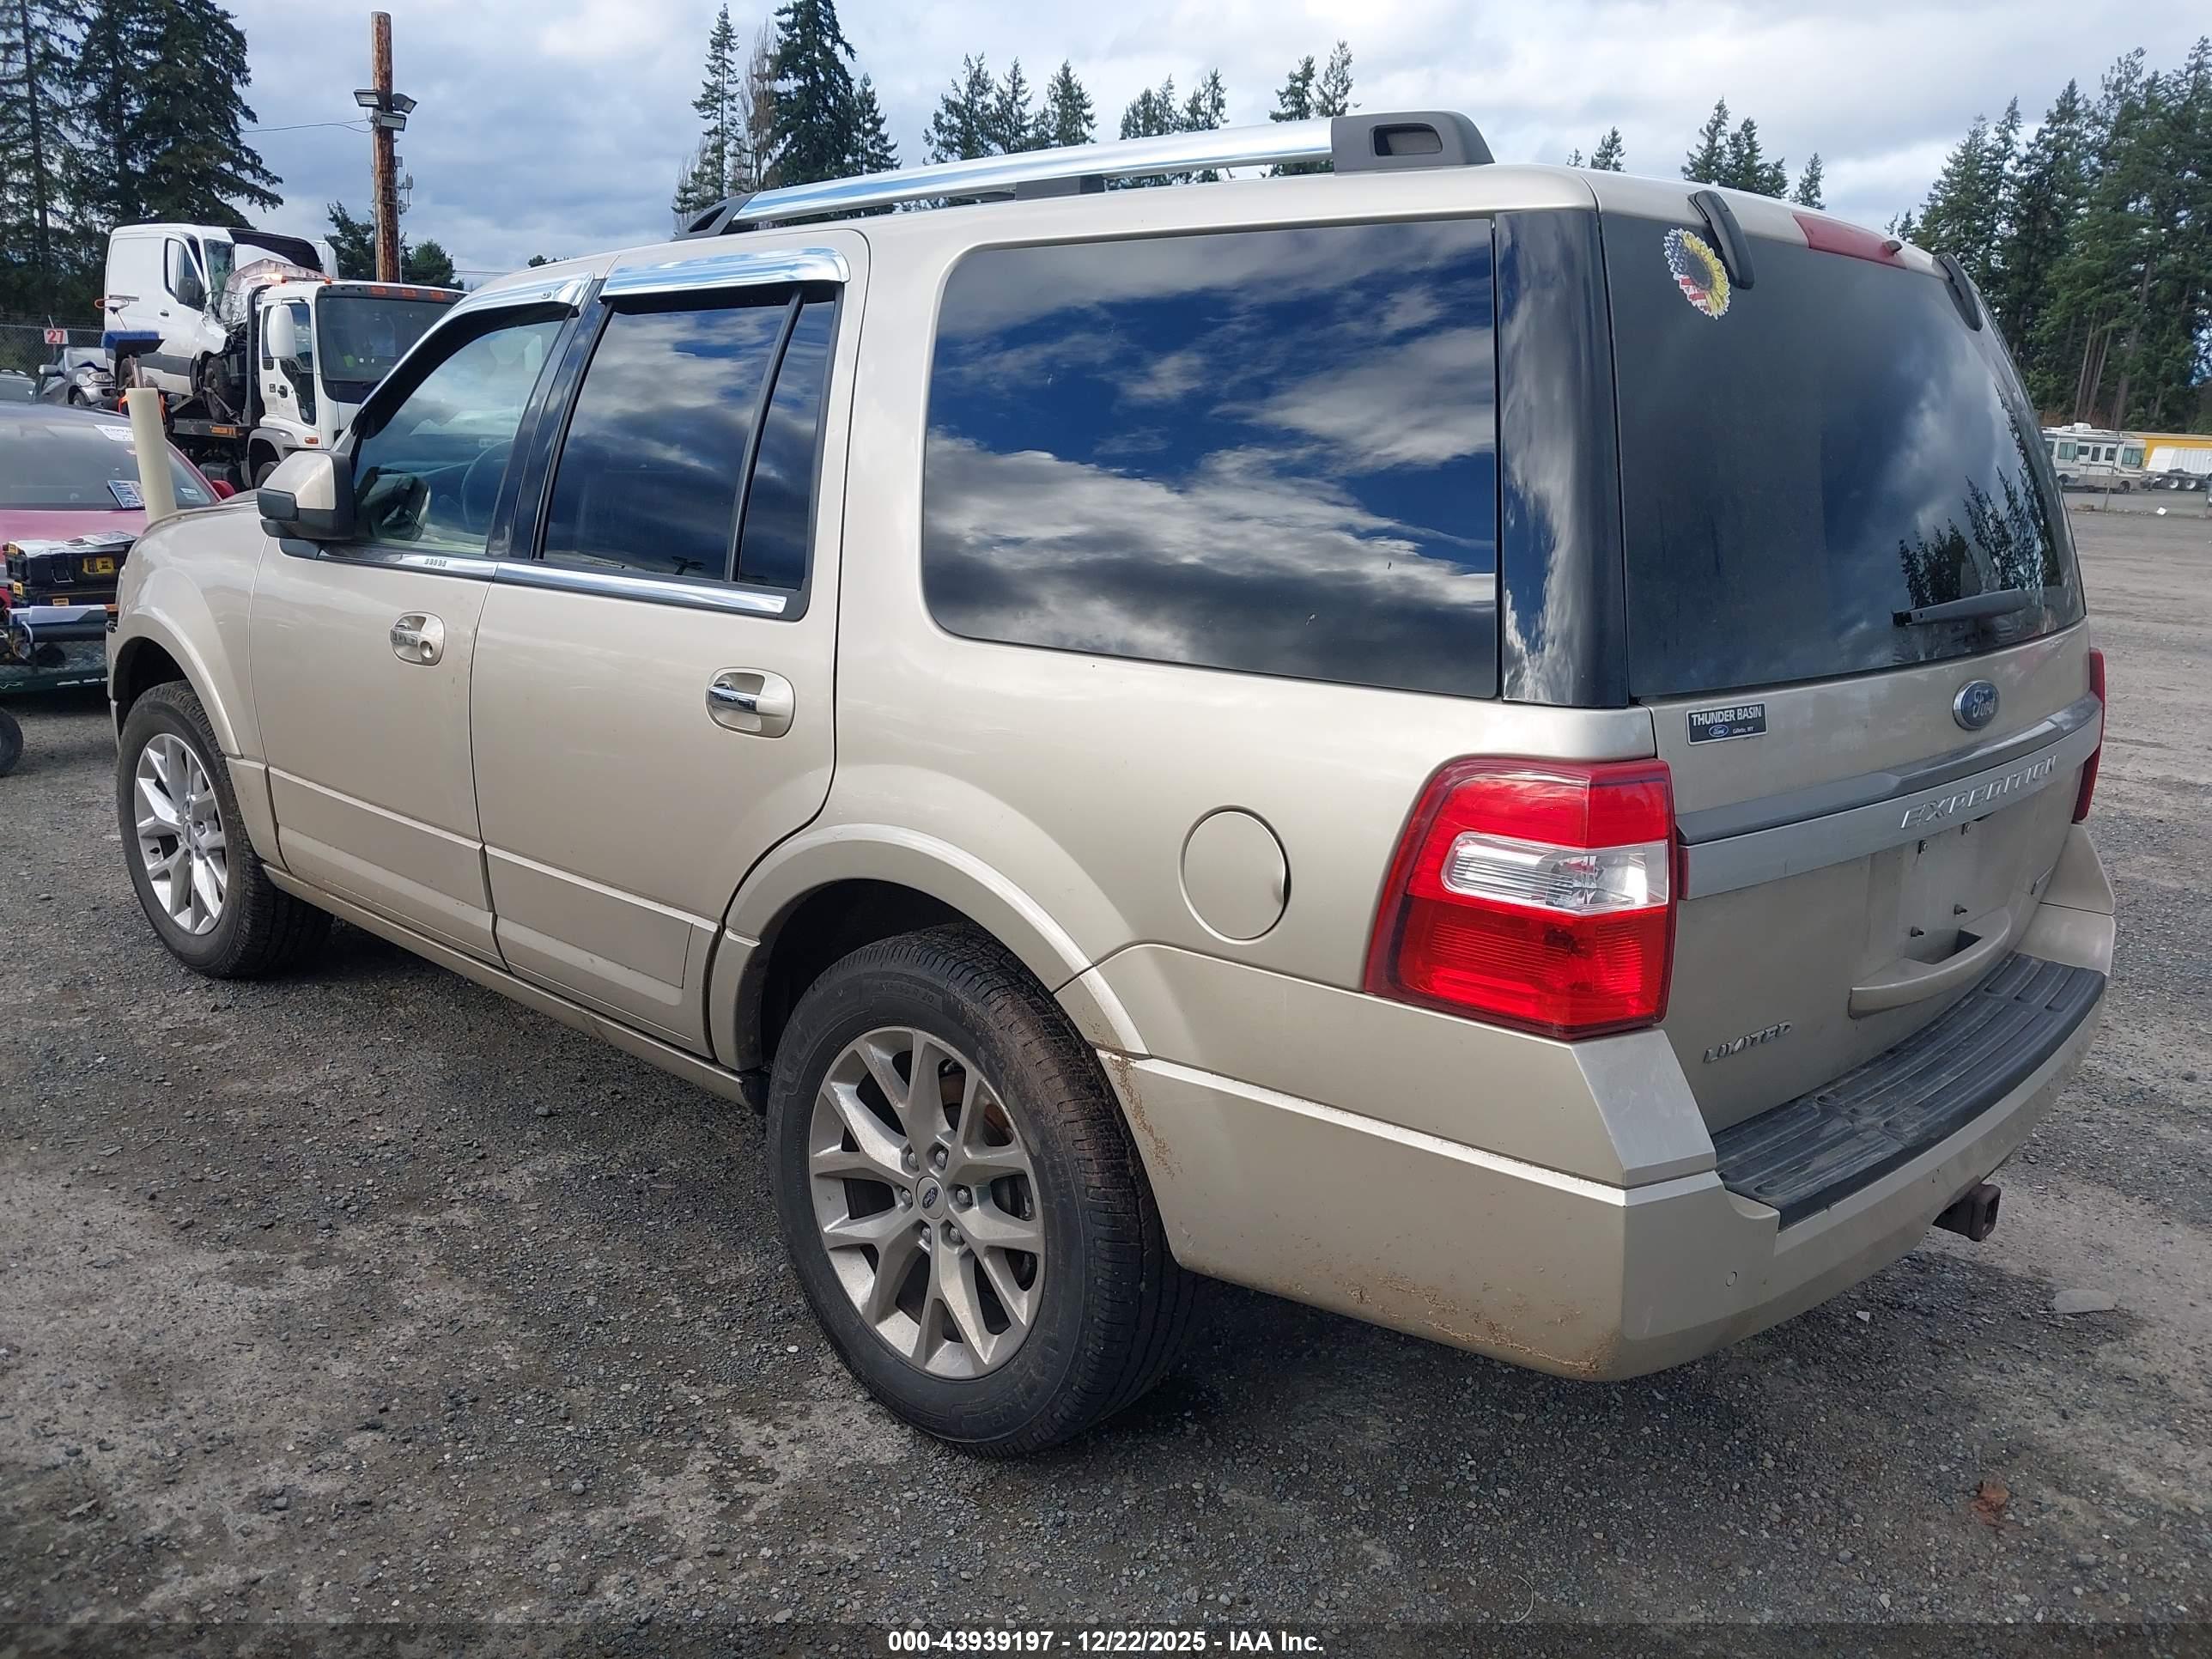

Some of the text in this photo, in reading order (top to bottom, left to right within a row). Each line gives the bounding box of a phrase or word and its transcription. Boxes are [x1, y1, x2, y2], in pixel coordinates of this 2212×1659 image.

[46, 329, 64, 343] 27
[1691, 705, 1762, 726] THUNDER BASIN
[1899, 752, 2058, 830] EXPEDITION
[1703, 1019, 1793, 1064] LIMITED
